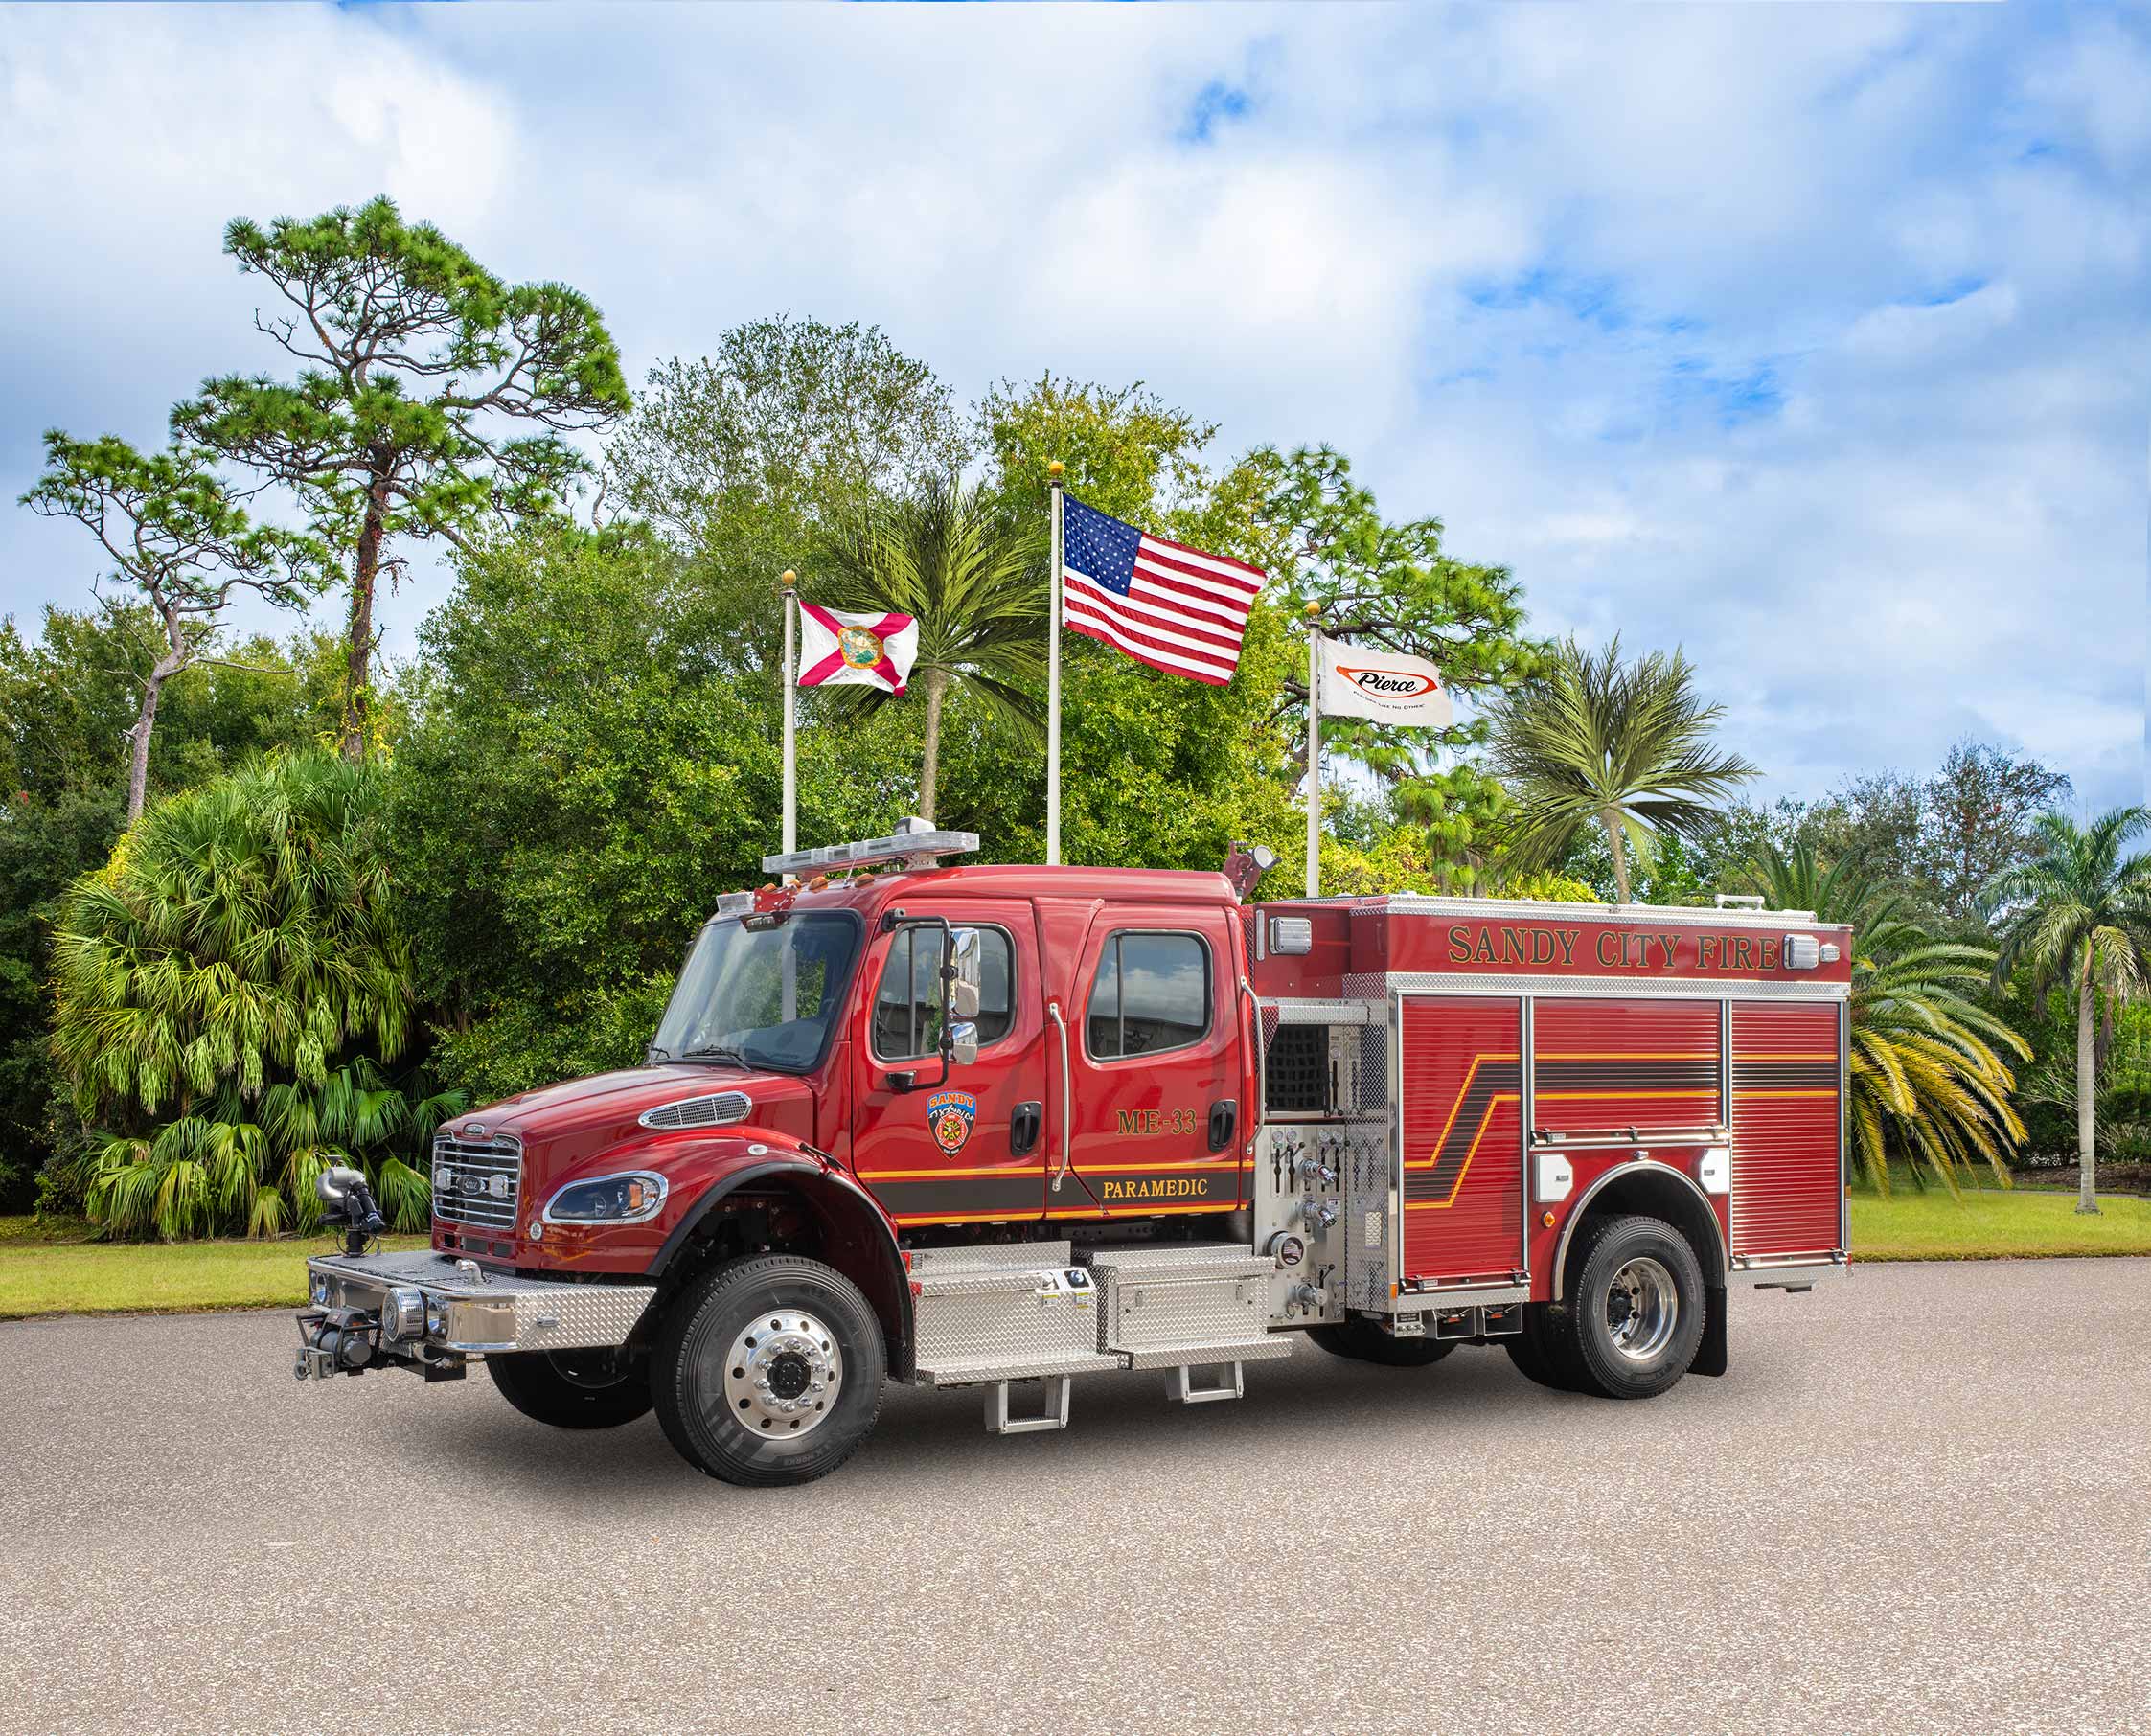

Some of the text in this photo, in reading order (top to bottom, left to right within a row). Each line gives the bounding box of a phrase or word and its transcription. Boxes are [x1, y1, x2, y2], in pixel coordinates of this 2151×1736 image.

[1358, 672, 1416, 692] Pierce
[1448, 925, 1779, 971] SANDY CITY FIRE
[929, 1093, 973, 1108] SANDY
[1116, 1108, 1197, 1135] ME-33
[1103, 1178, 1208, 1199] PARAMEDIC
